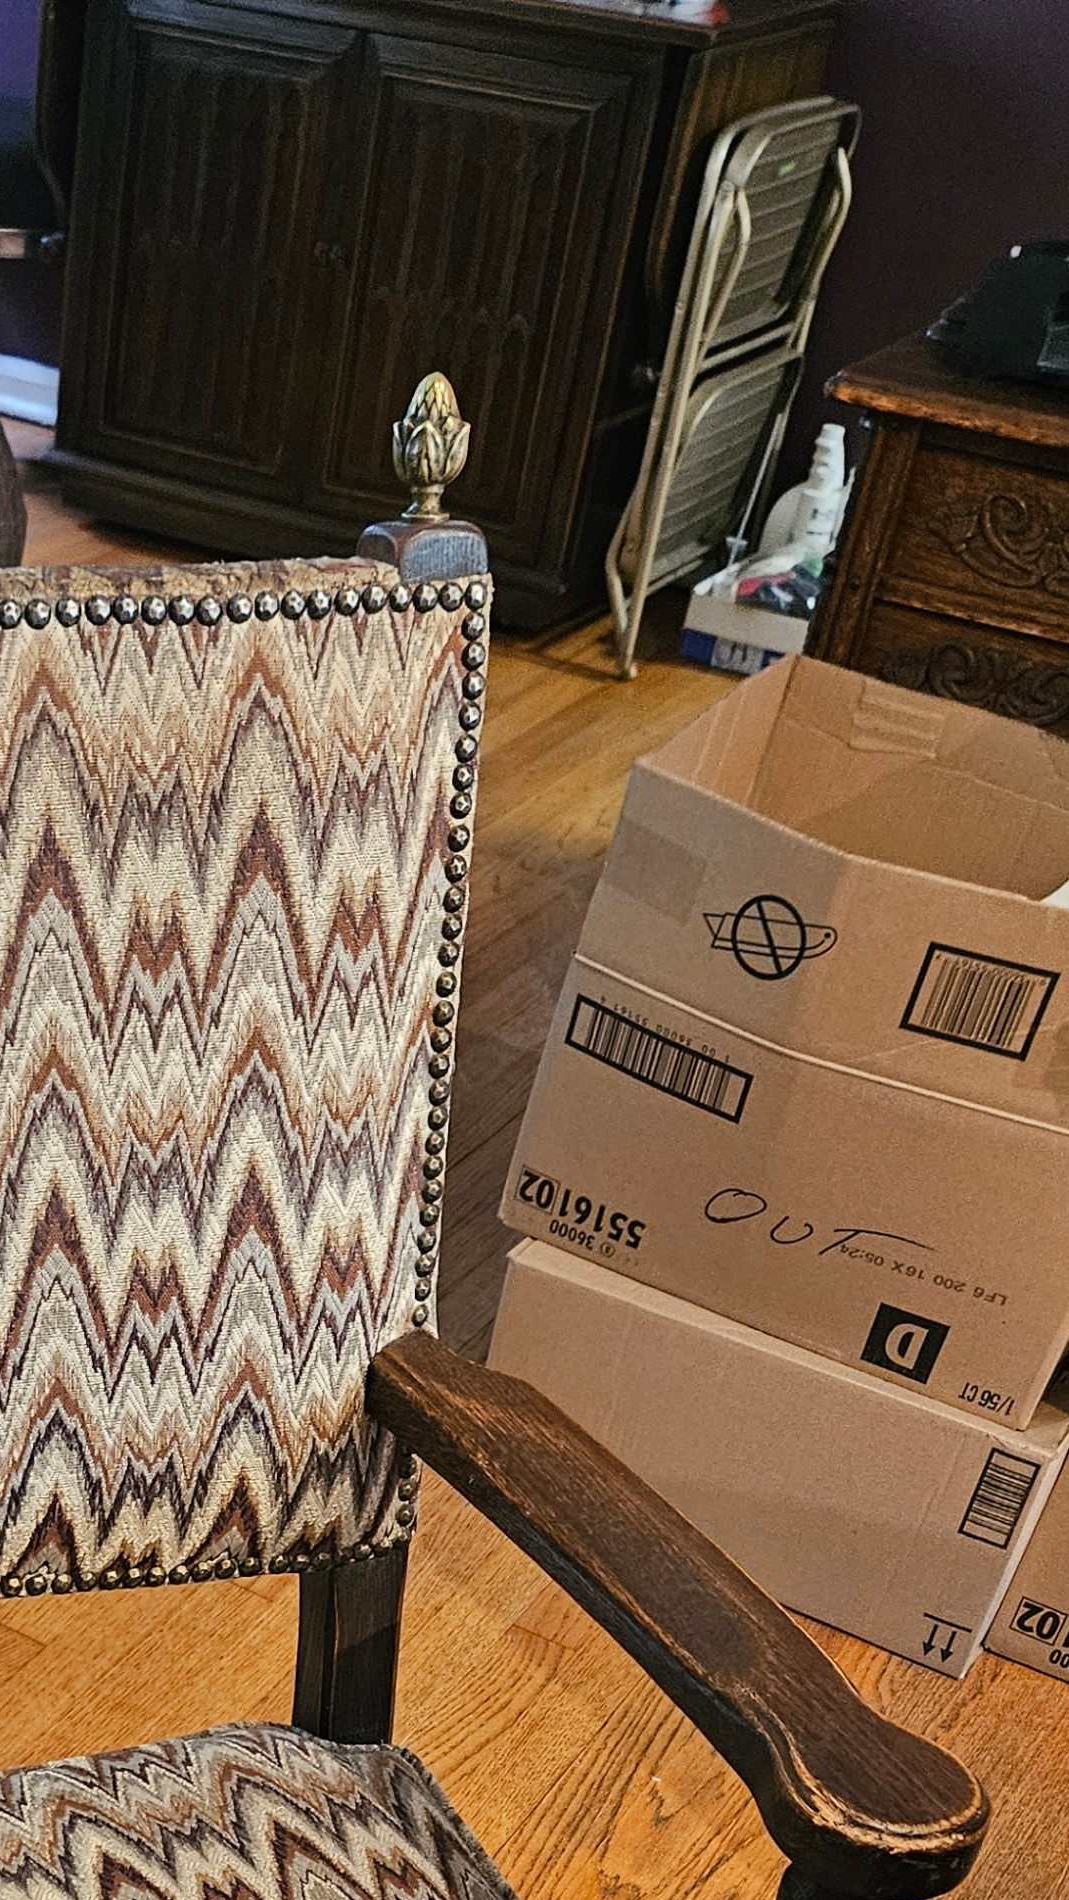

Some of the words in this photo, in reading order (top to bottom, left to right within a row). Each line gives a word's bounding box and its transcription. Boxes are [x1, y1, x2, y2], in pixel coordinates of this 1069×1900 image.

[549, 1219, 595, 1250] 36000
[704, 1188, 938, 1255] OUT
[891, 1260, 925, 1280] 16X
[933, 1274, 967, 1294] 200
[884, 1322, 929, 1370] D
[958, 1381, 979, 1402] CT
